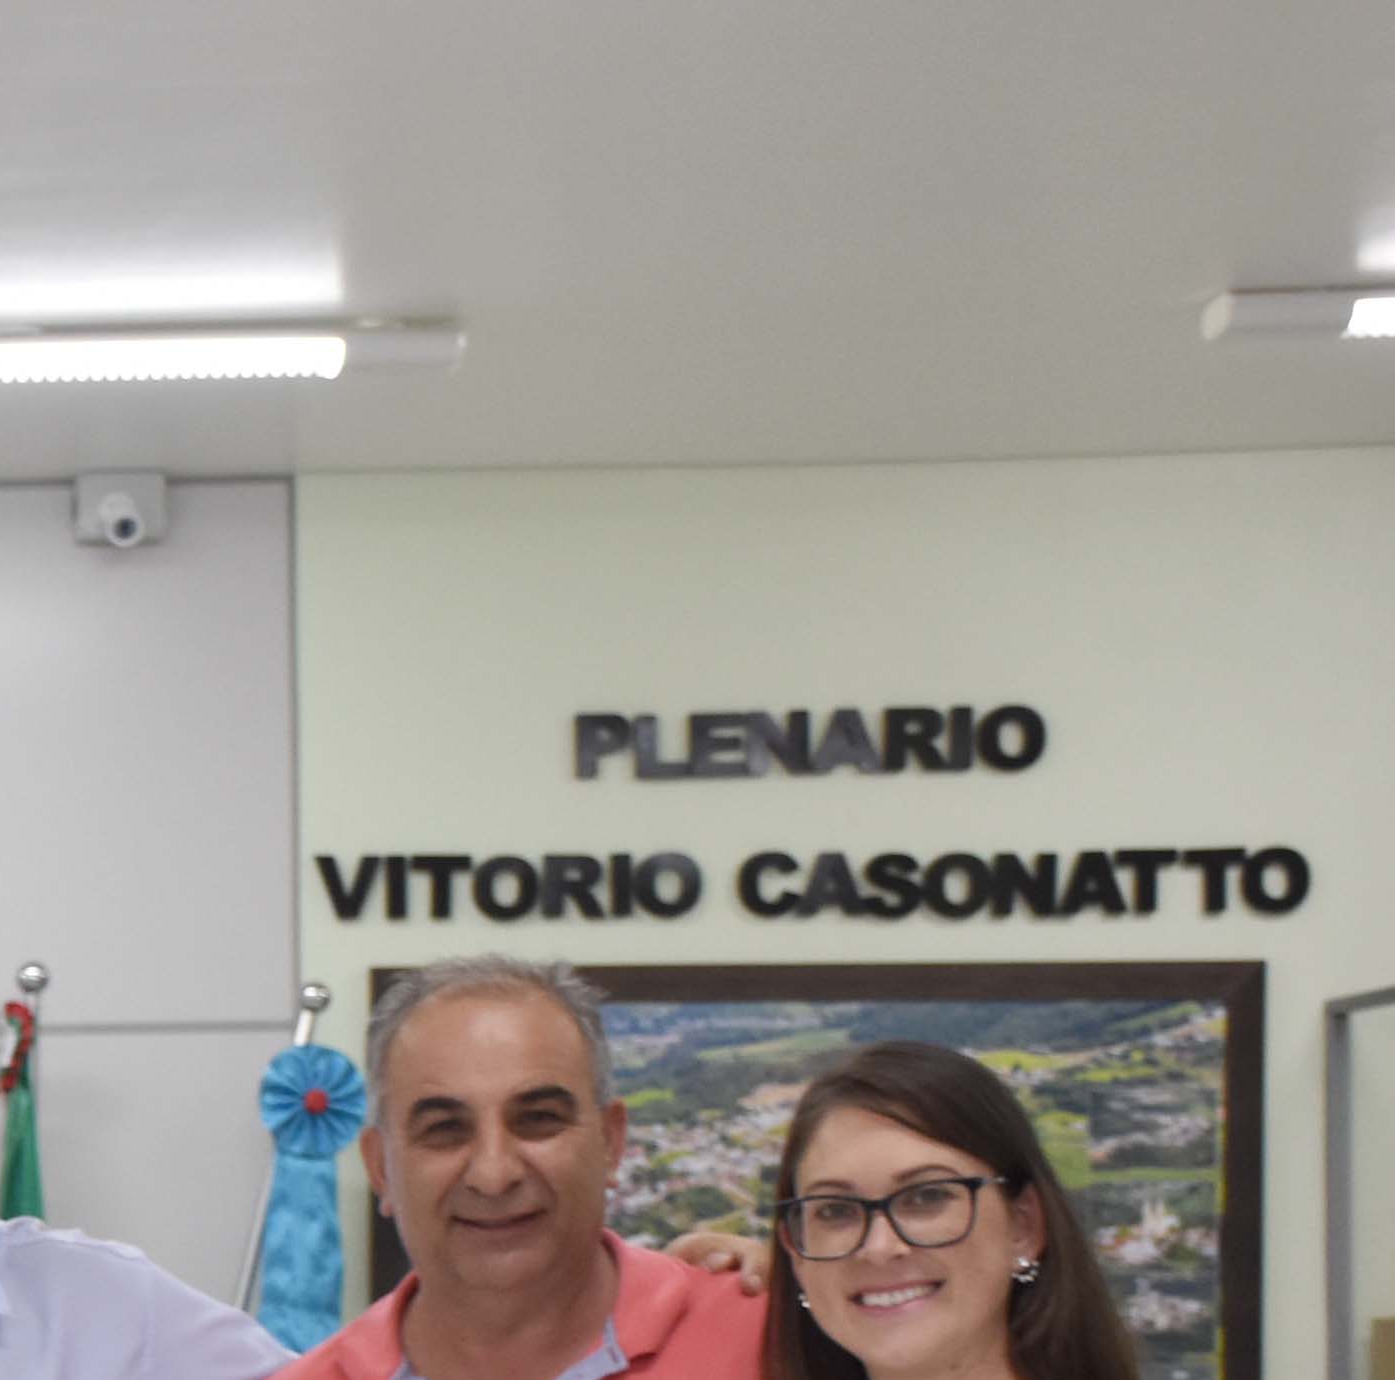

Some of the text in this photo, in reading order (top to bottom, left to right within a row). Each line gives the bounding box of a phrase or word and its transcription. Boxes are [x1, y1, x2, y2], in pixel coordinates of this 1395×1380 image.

[574, 704, 1047, 782] PLENARIO
[314, 845, 1310, 923] VITORIO CASONATTO
